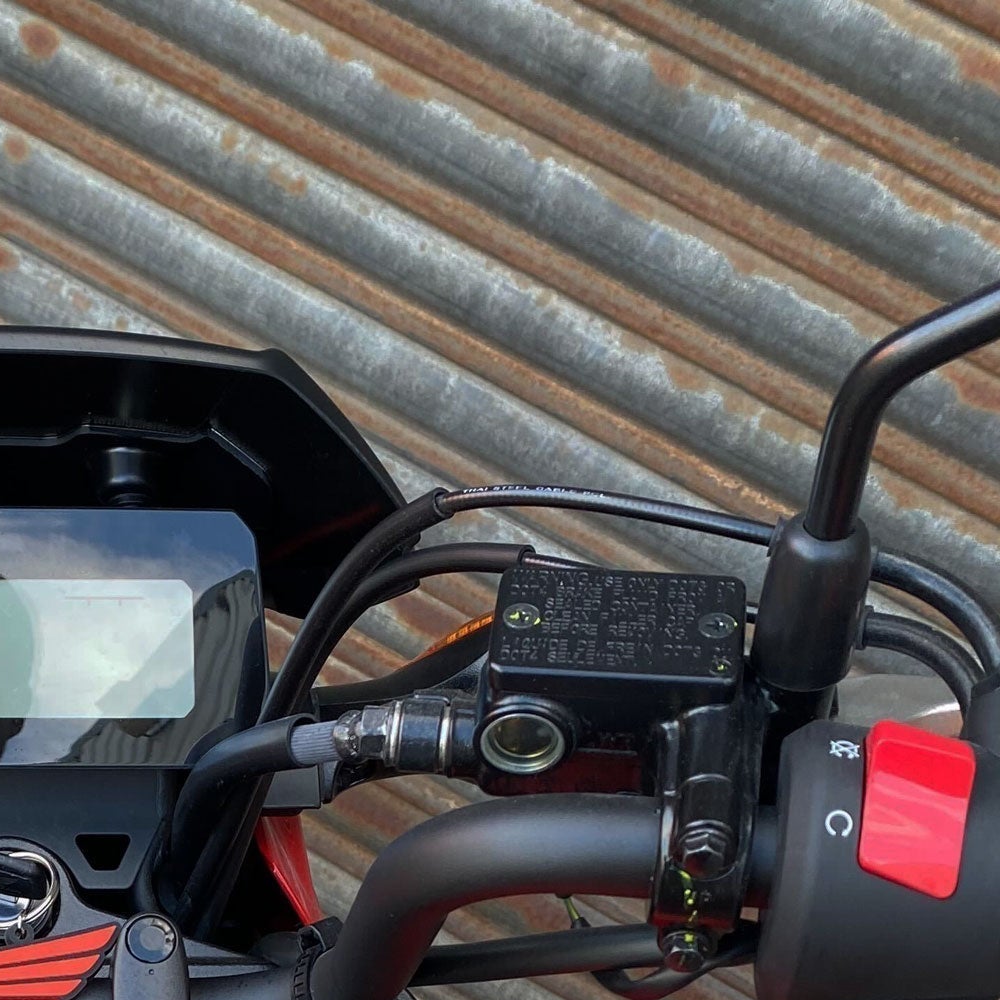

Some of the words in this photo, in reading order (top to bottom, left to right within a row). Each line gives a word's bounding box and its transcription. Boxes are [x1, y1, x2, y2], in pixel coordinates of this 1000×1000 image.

[462, 486, 488, 494] THAI
[544, 597, 602, 612] SEALED
[540, 622, 599, 636] BEFORE
[576, 640, 597, 652] DE
